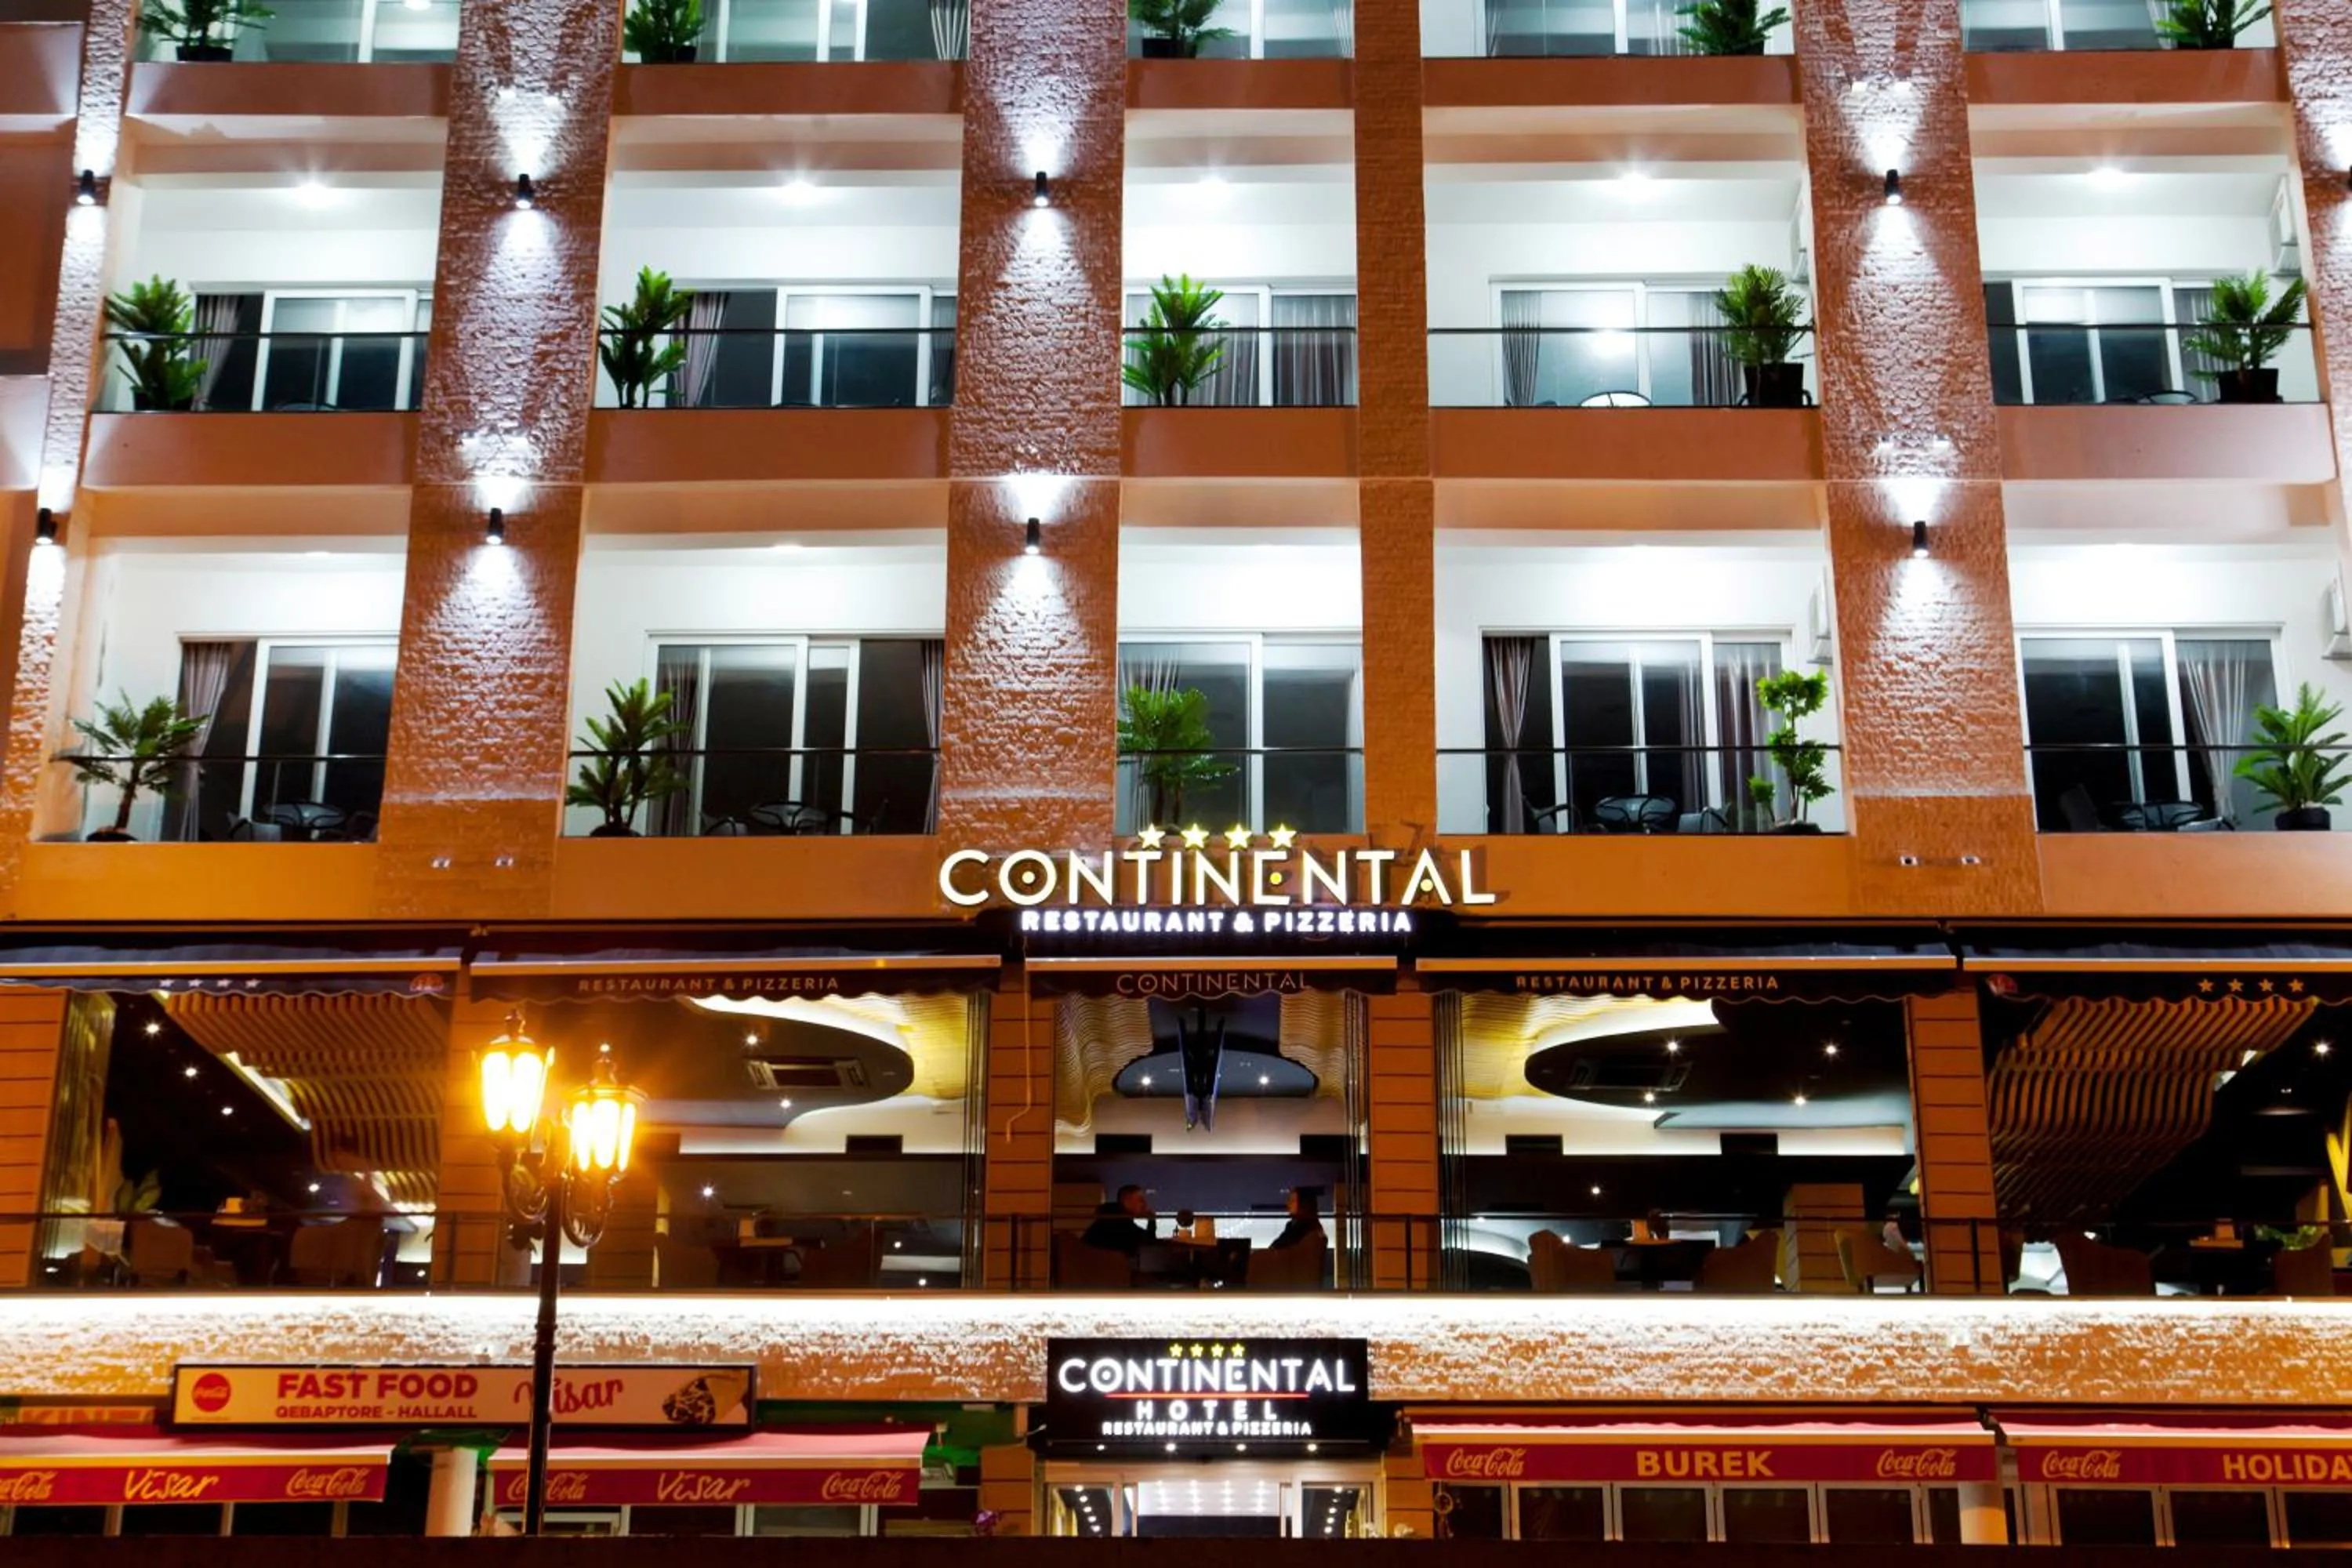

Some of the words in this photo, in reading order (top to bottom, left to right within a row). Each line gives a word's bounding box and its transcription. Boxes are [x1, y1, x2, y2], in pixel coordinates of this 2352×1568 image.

[939, 848, 1496, 906] CONTINENTAL
[1021, 910, 1228, 932] RESTAURANT
[1233, 912, 1254, 932] &
[1264, 910, 1413, 933] PIZZERIA
[578, 978, 716, 992] RESTAURANT
[723, 978, 735, 991] &
[742, 977, 839, 991] PIZZERIA
[1116, 972, 1311, 994] CONTINENTAL
[1516, 975, 1654, 989] RESTAURANT
[1661, 976, 1674, 989] &
[1680, 976, 1780, 990] PIZZERIA
[277, 1374, 368, 1399] FAST
[377, 1373, 478, 1399] FOOD
[1058, 1358, 1356, 1393] CONTINENTAL
[397, 1405, 477, 1418] HALLALL
[1137, 1399, 1277, 1421] HOTEL
[1102, 1421, 1214, 1436] RESTAURANT
[1216, 1422, 1229, 1436] &
[1232, 1421, 1312, 1436] PIZZERIA
[1635, 1450, 1776, 1477] BUREK
[2223, 1454, 2352, 1481] HOLIDA
[124, 1468, 220, 1500] Visar
[656, 1471, 751, 1501] Visar
